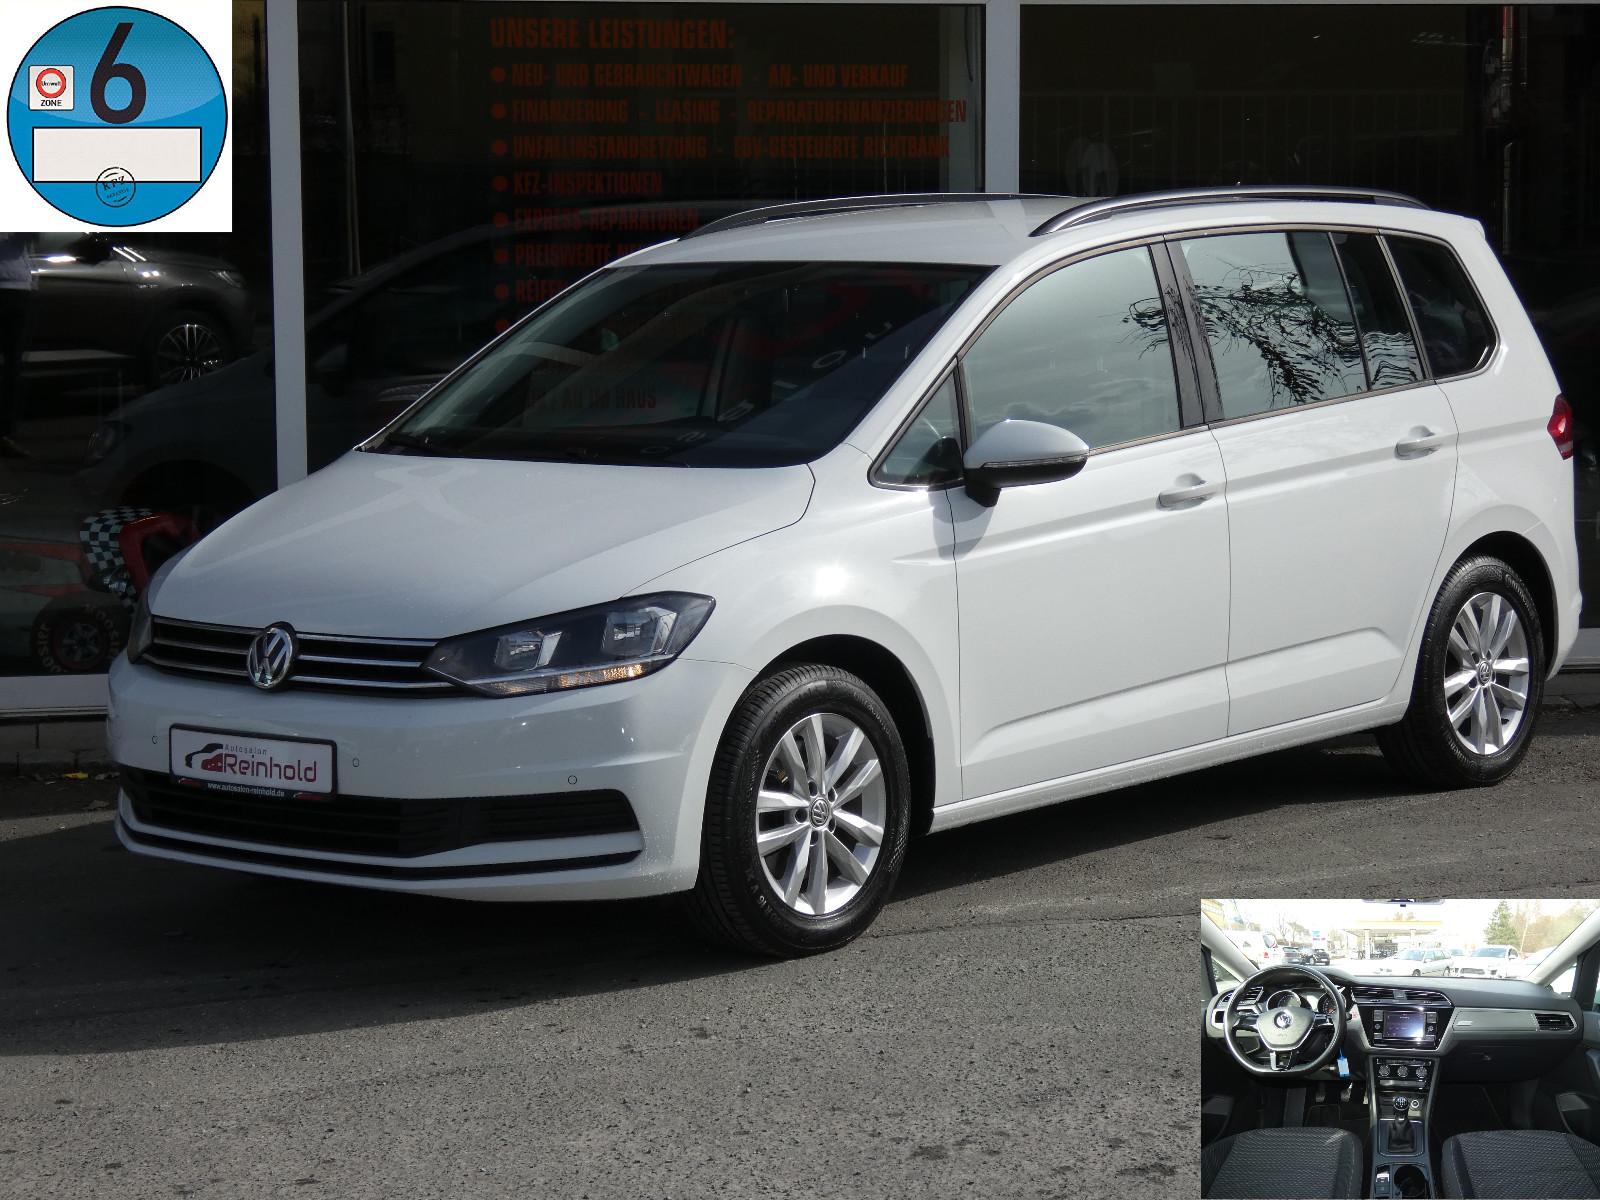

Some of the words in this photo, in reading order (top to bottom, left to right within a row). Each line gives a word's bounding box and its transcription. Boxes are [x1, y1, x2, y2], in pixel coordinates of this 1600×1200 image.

[490, 17, 580, 48] UNSERE
[588, 17, 736, 48] LEISTUNGEN:
[512, 64, 550, 87] NEU-
[555, 64, 590, 87] UND
[594, 64, 742, 87] GEBRAUCHTWAGEN
[768, 64, 797, 87] AN-
[803, 64, 836, 87] UND
[840, 64, 909, 87] VERKAUF
[512, 99, 628, 123] FINANZIERUNG
[655, 99, 721, 123] LEASING
[746, 99, 967, 123] REPARATURFINANZIERUNGEN
[513, 136, 707, 159] UNFALLINSTANDSETZUNG
[863, 135, 950, 159] RICHTBANK
[513, 171, 663, 195] KFZ-INSPEKTIONEN
[514, 206, 699, 232] EXPRESS-REPARATUREN
[514, 242, 611, 267] PREISWERTE
[224, 743, 268, 756] Autosalon
[224, 752, 317, 783] Reinhold
[207, 782, 286, 798] www.autosalon-reinhold.de
